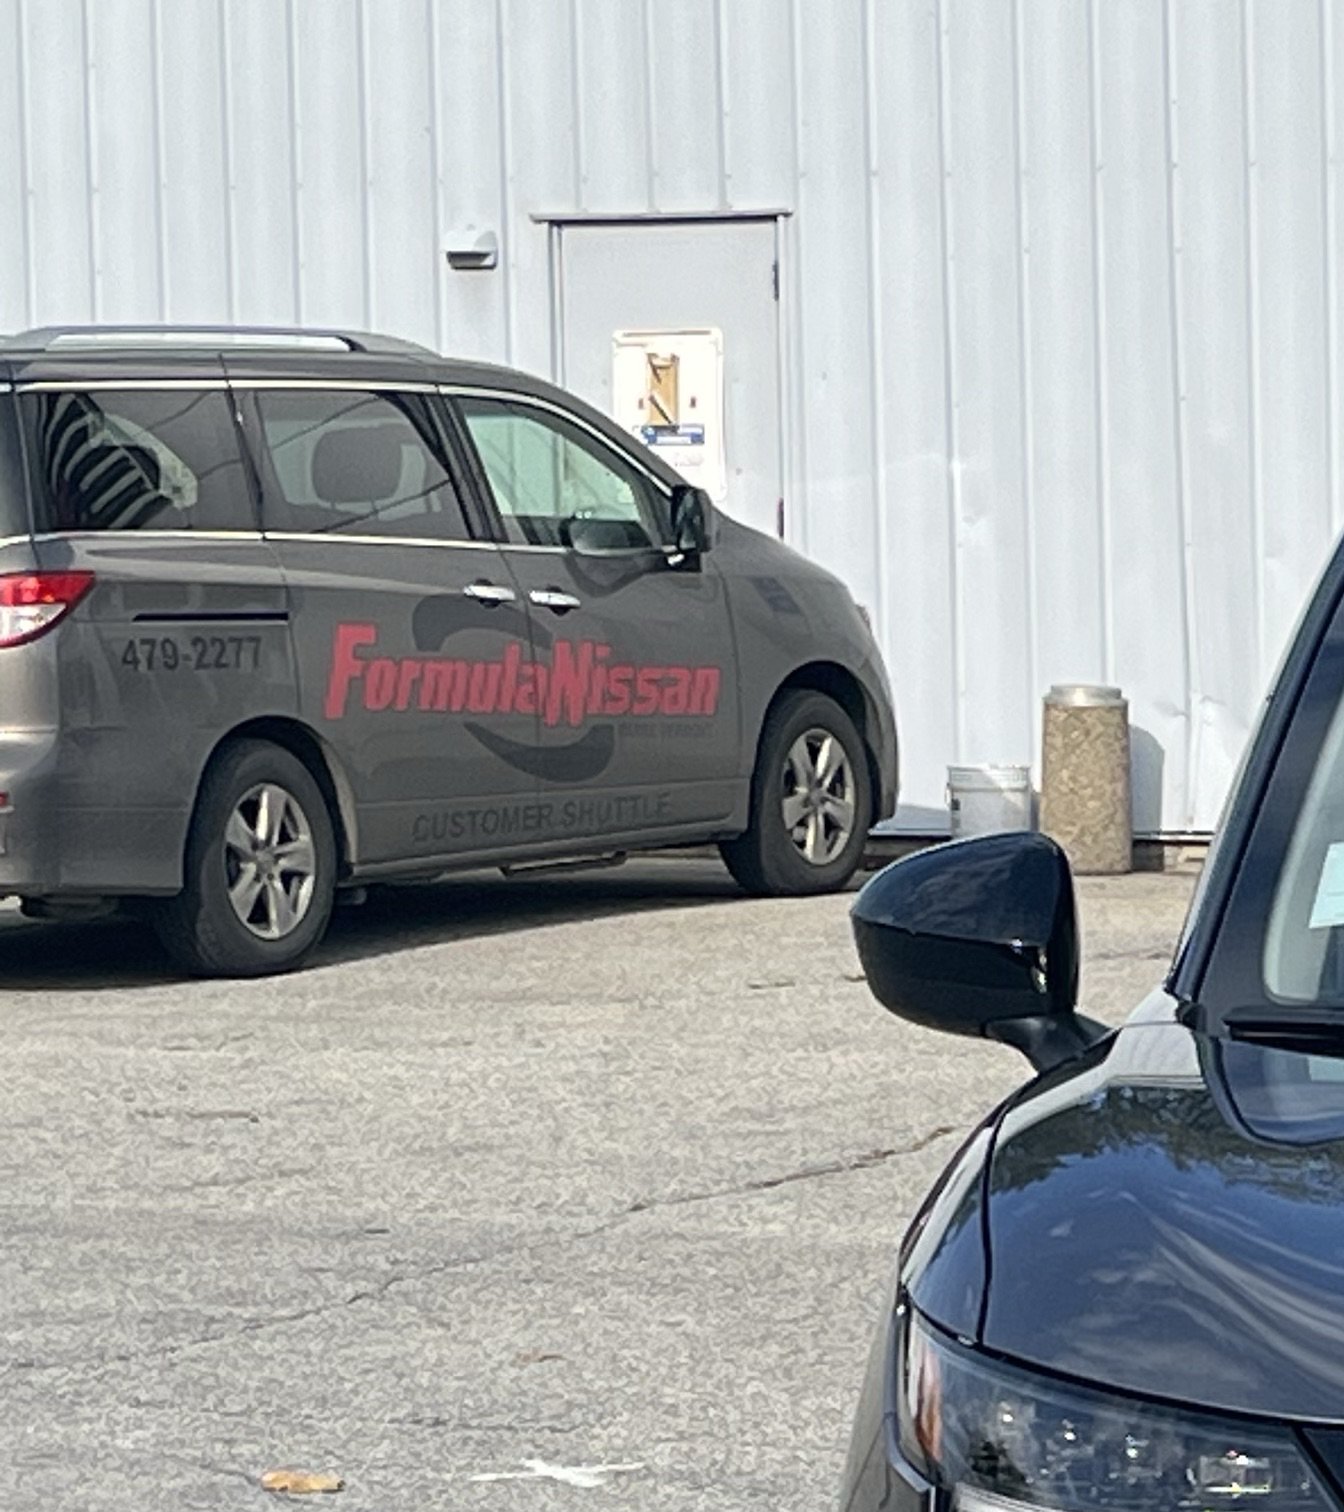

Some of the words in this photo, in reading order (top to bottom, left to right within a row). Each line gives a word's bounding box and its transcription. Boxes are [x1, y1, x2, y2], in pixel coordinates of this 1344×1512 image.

[122, 636, 261, 671] 479-2277
[413, 803, 553, 842] CUSTOMER
[563, 794, 670, 828] SHUTTLE
